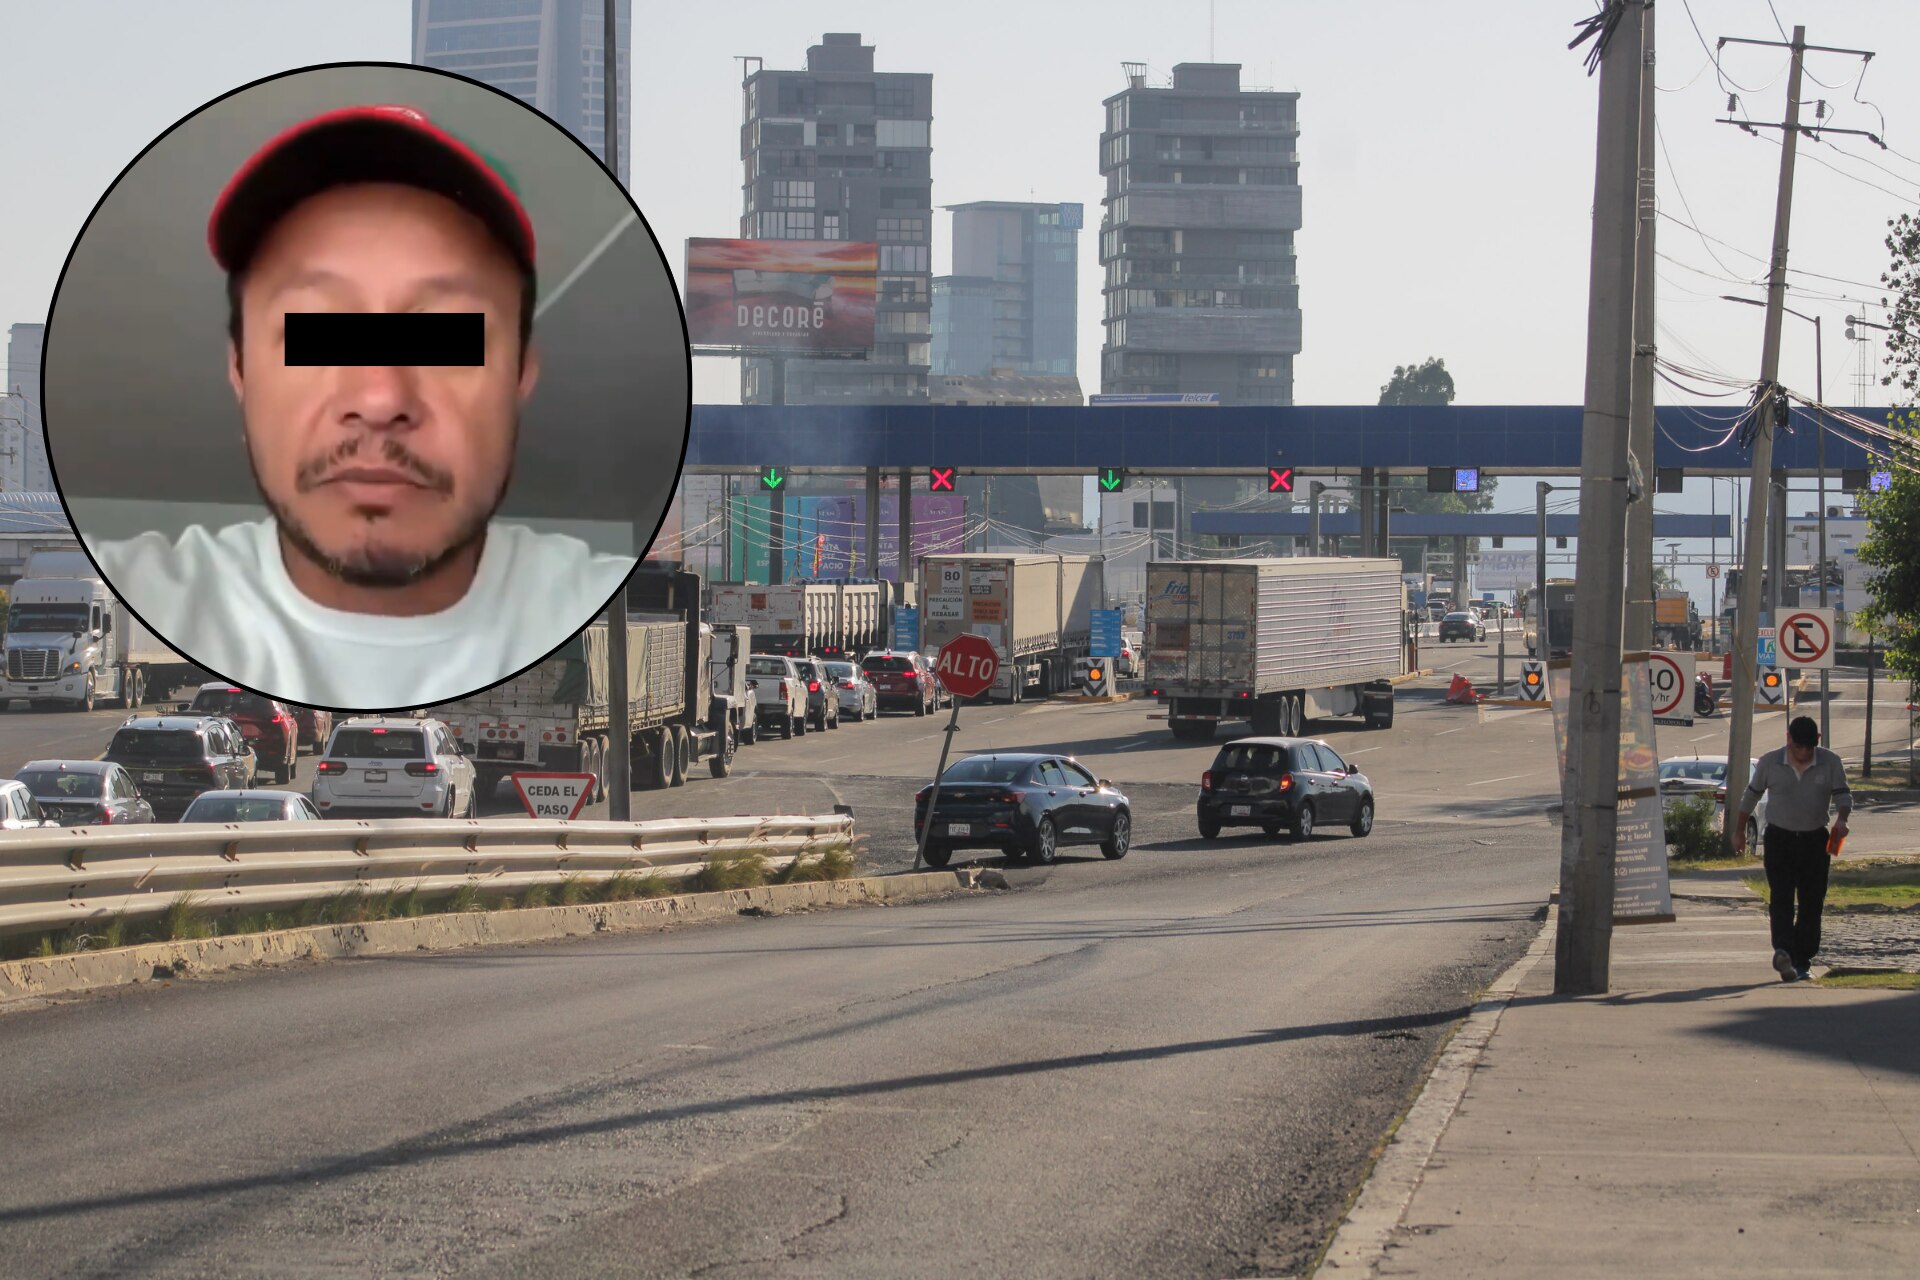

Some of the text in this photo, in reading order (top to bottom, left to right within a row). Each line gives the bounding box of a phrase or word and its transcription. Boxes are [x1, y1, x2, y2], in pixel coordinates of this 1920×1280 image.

[944, 571, 960, 581] 80
[938, 652, 994, 681] ALTO
[528, 786, 579, 797] CEDA EL
[537, 804, 569, 815] PASO
